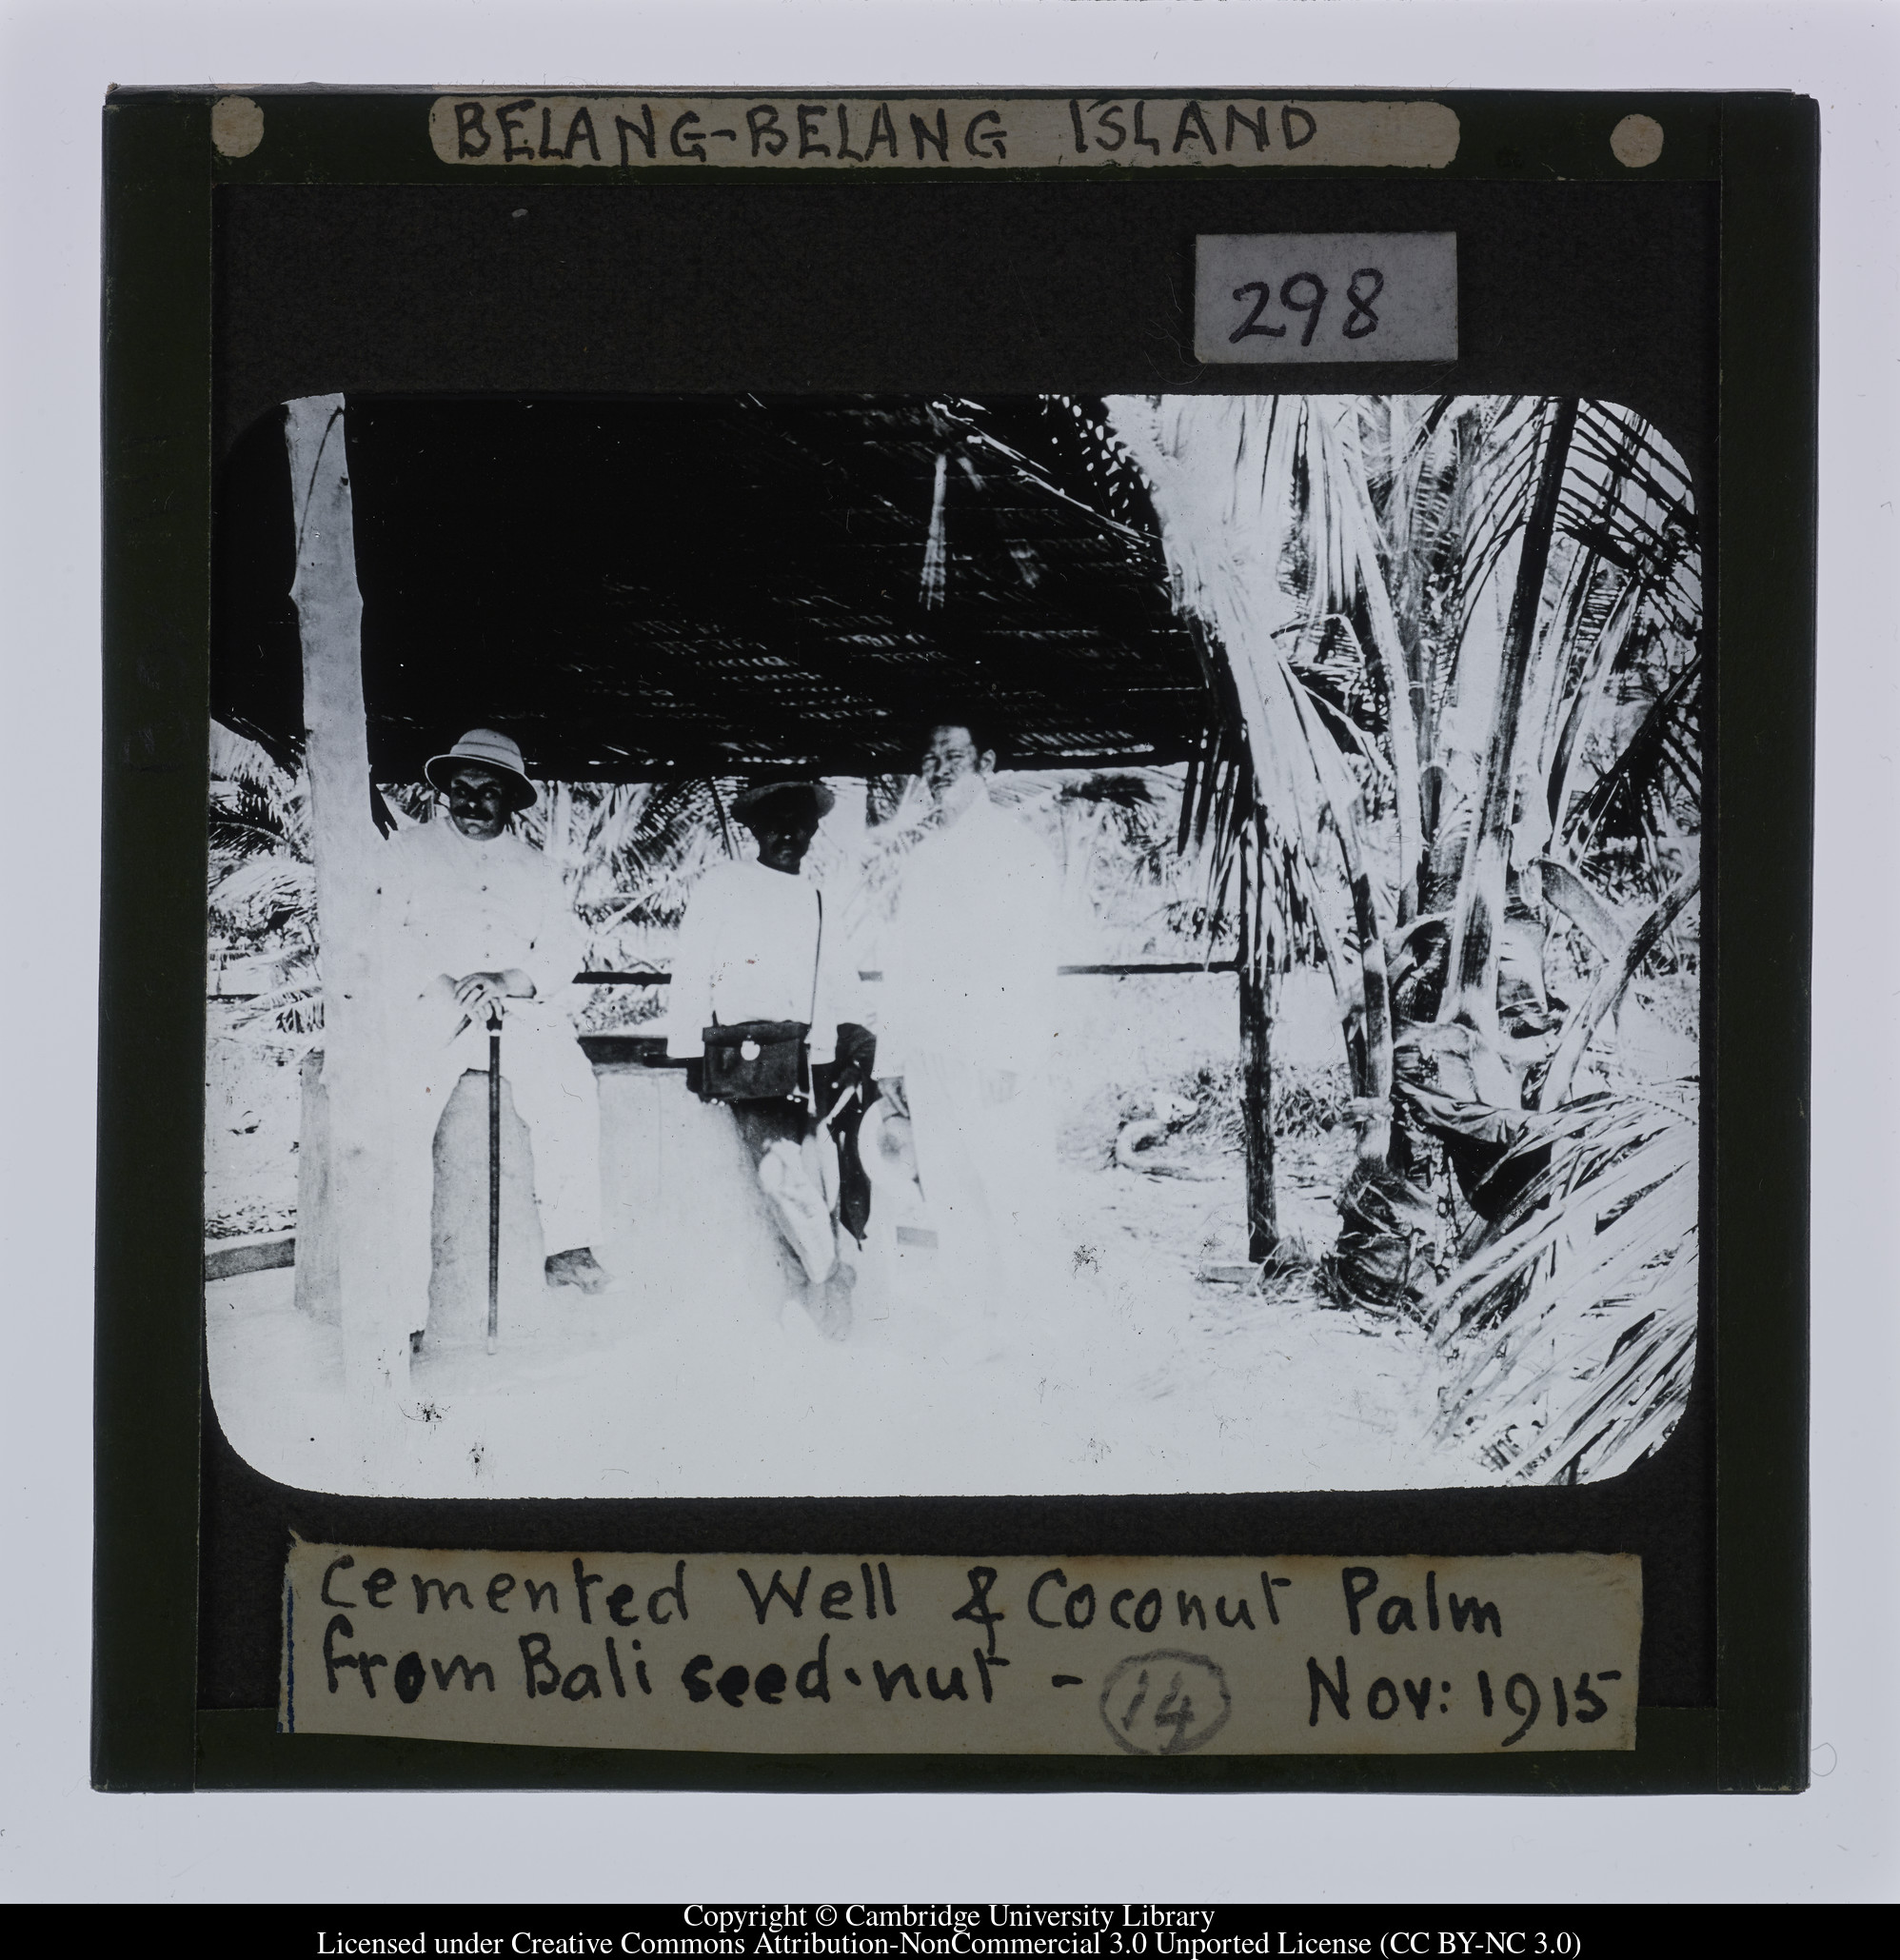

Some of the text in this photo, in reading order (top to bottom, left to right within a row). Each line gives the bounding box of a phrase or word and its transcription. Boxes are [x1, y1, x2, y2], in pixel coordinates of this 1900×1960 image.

[454, 99, 1317, 167] BELANG-BELANG ISLAND
[1229, 267, 1385, 346] 298
[321, 1554, 1503, 1654] Cemented Well & Coconut Palm
[324, 1614, 495, 1704] from
[519, 1632, 652, 1701] Bali
[1306, 1655, 1622, 1748] Nov: 1915
